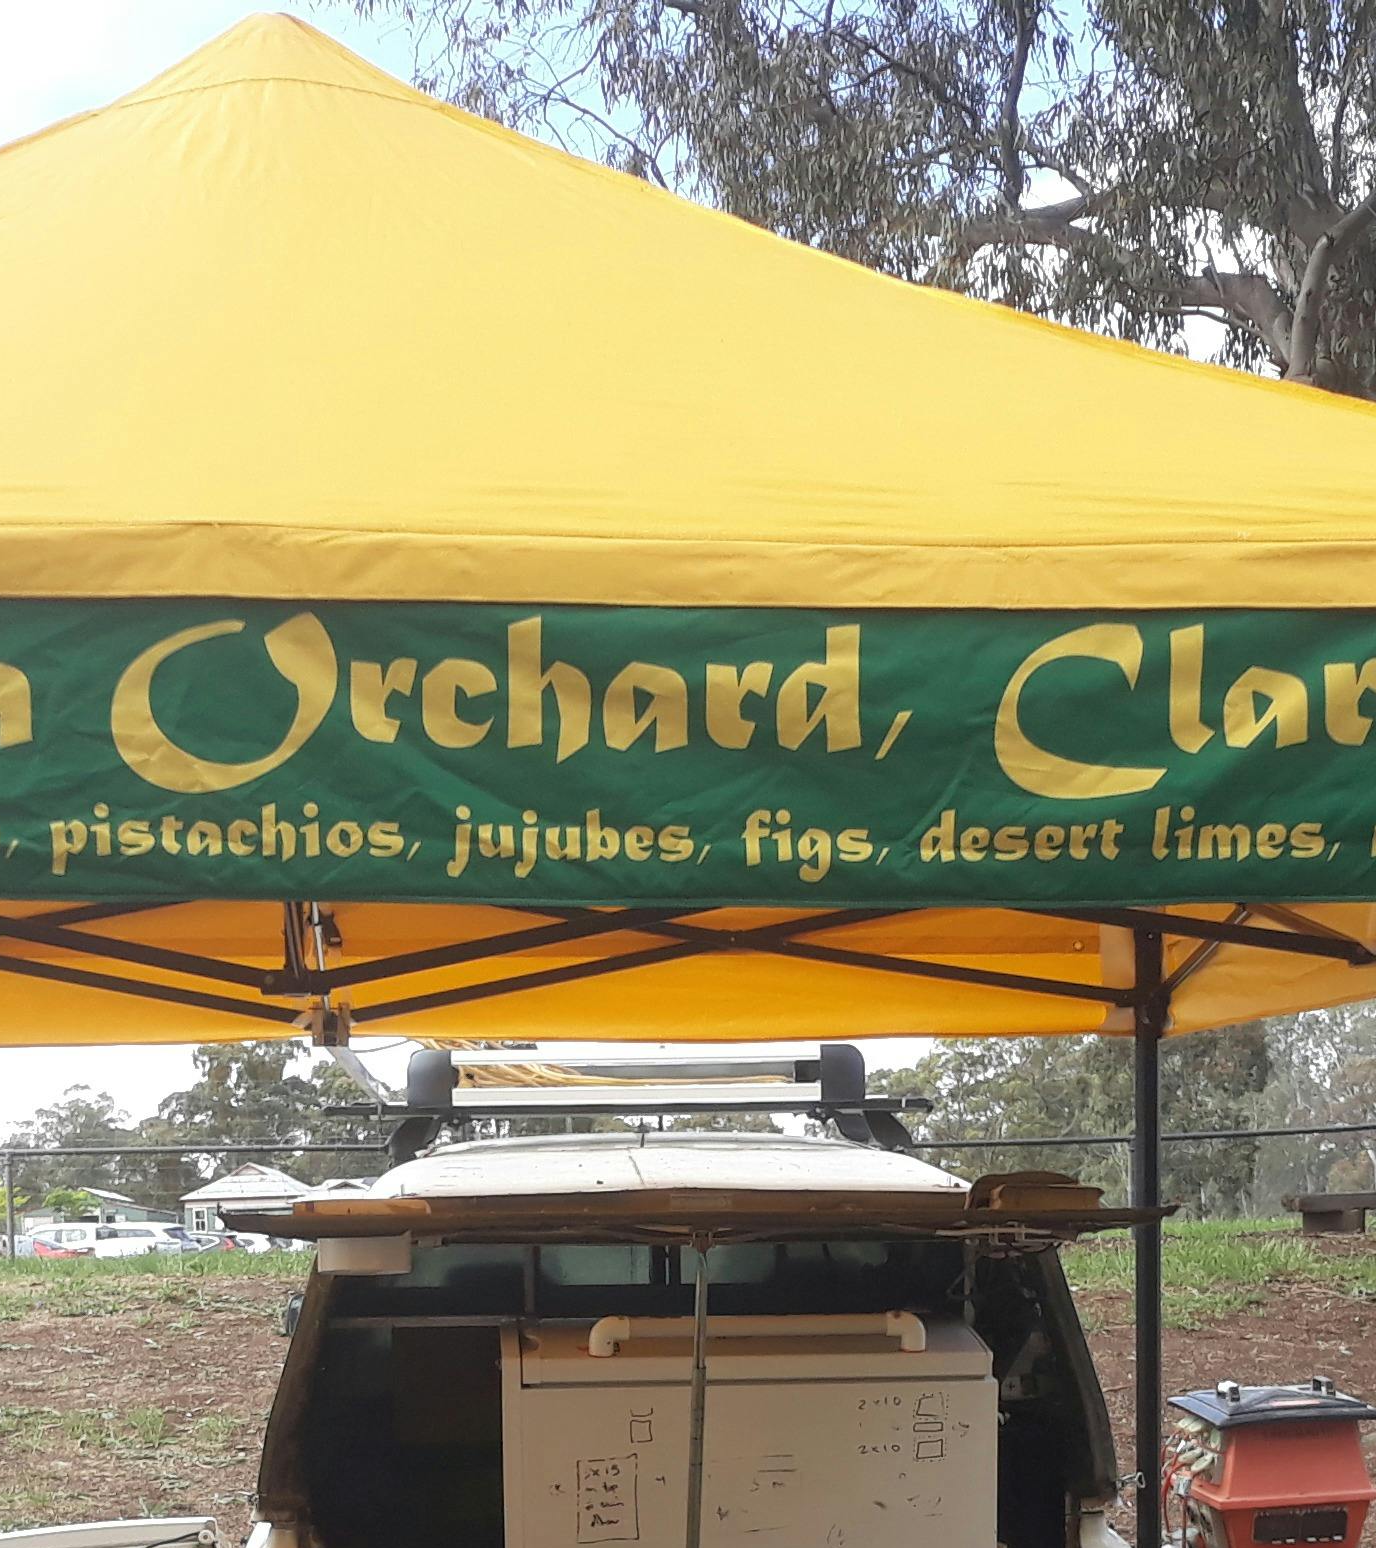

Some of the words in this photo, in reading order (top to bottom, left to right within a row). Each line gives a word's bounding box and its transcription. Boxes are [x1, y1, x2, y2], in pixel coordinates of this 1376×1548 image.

[110, 611, 913, 794] Orchard,
[50, 803, 420, 876] pistachios,
[446, 807, 712, 878] jujubes,
[743, 809, 888, 882] figs,
[919, 808, 1126, 861] desert
[1151, 806, 1341, 861] limes,
